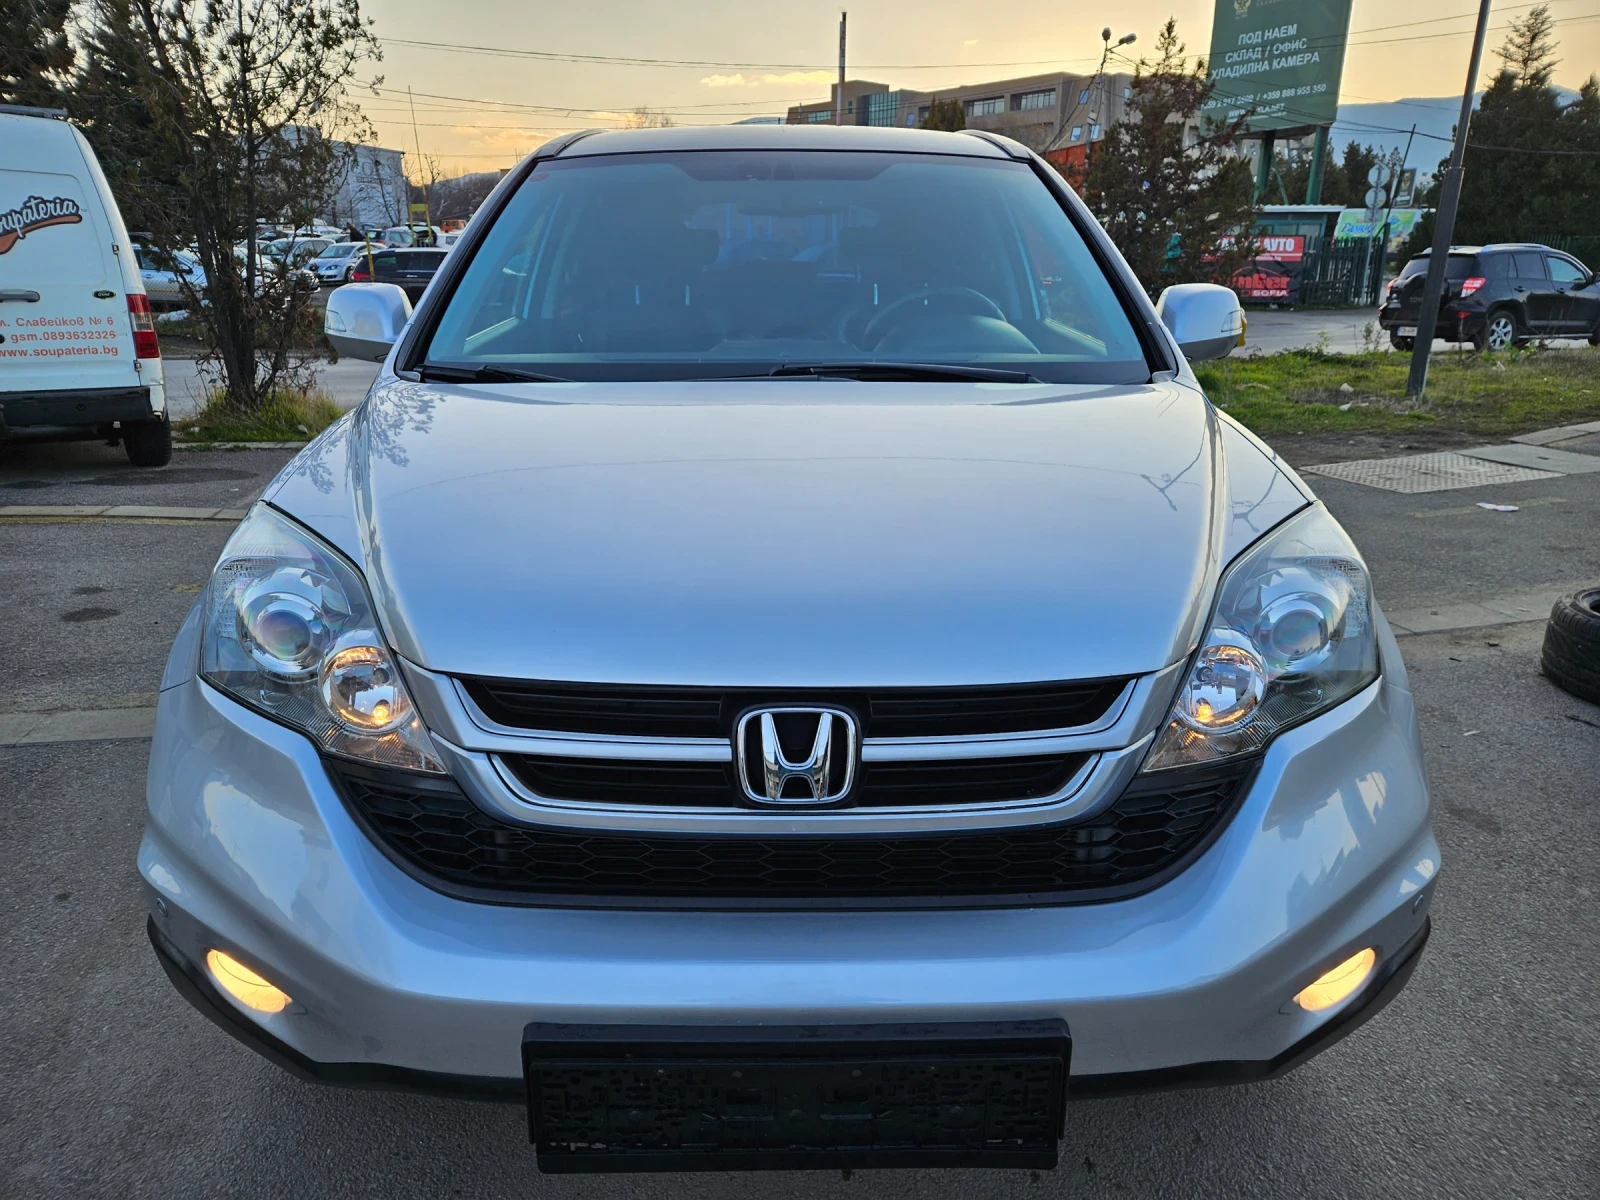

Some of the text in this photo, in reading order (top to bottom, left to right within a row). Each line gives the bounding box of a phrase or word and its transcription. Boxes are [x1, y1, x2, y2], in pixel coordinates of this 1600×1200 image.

[1238, 24, 1298, 45] ПОД НАЕМ
[1225, 38, 1308, 63] СКЛАД / ОФИС
[1211, 52, 1320, 80] ХЛАДИЛНА КАМЕРА
[1312, 83, 1327, 93] 350
[16, 317, 84, 327] Славейков
[89, 316, 102, 326] №
[107, 316, 114, 326] 6
[10, 330, 116, 343] gsm.0893632326
